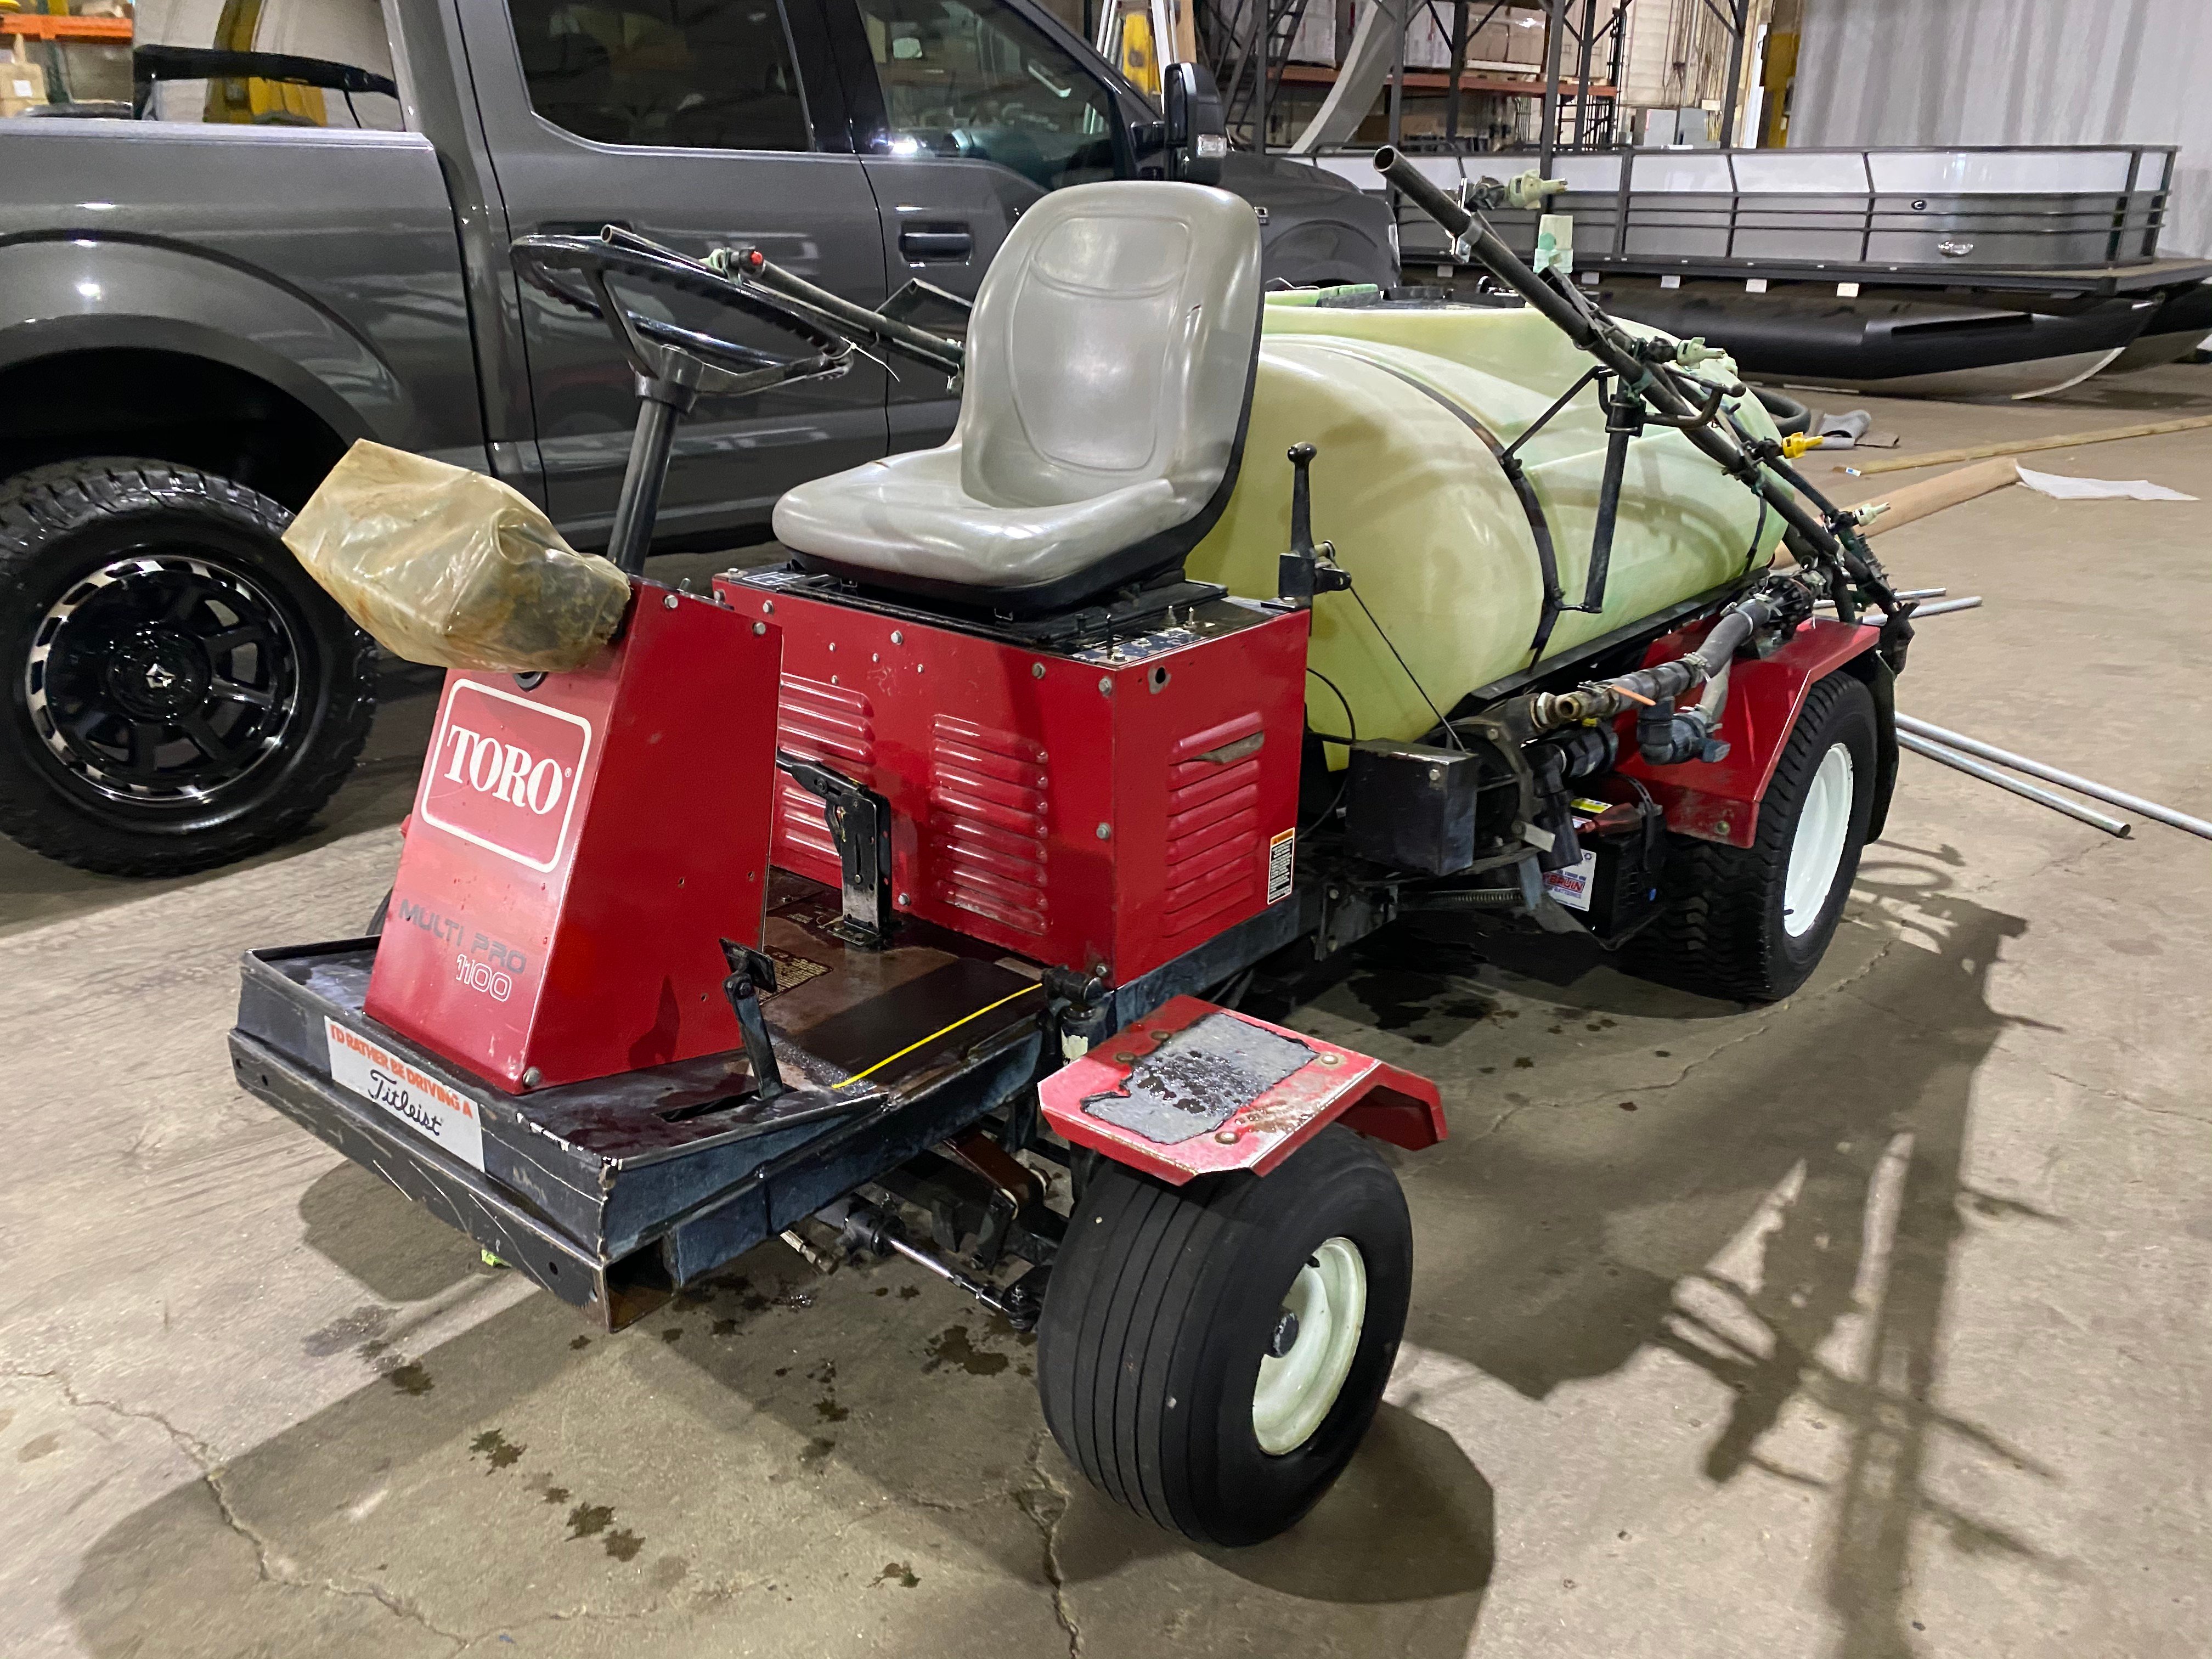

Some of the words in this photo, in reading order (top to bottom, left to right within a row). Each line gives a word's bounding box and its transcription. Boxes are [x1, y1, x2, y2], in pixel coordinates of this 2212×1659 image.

[443, 724, 563, 815] TORO
[398, 898, 464, 947] MULTI
[470, 933, 527, 974] PRO
[455, 953, 512, 1002] 1100
[346, 1032, 389, 1070] RATHER
[390, 1058, 406, 1080] BE
[406, 1068, 461, 1111] DRIVING
[462, 1100, 473, 1119] A
[368, 1069, 442, 1136] Titleist
